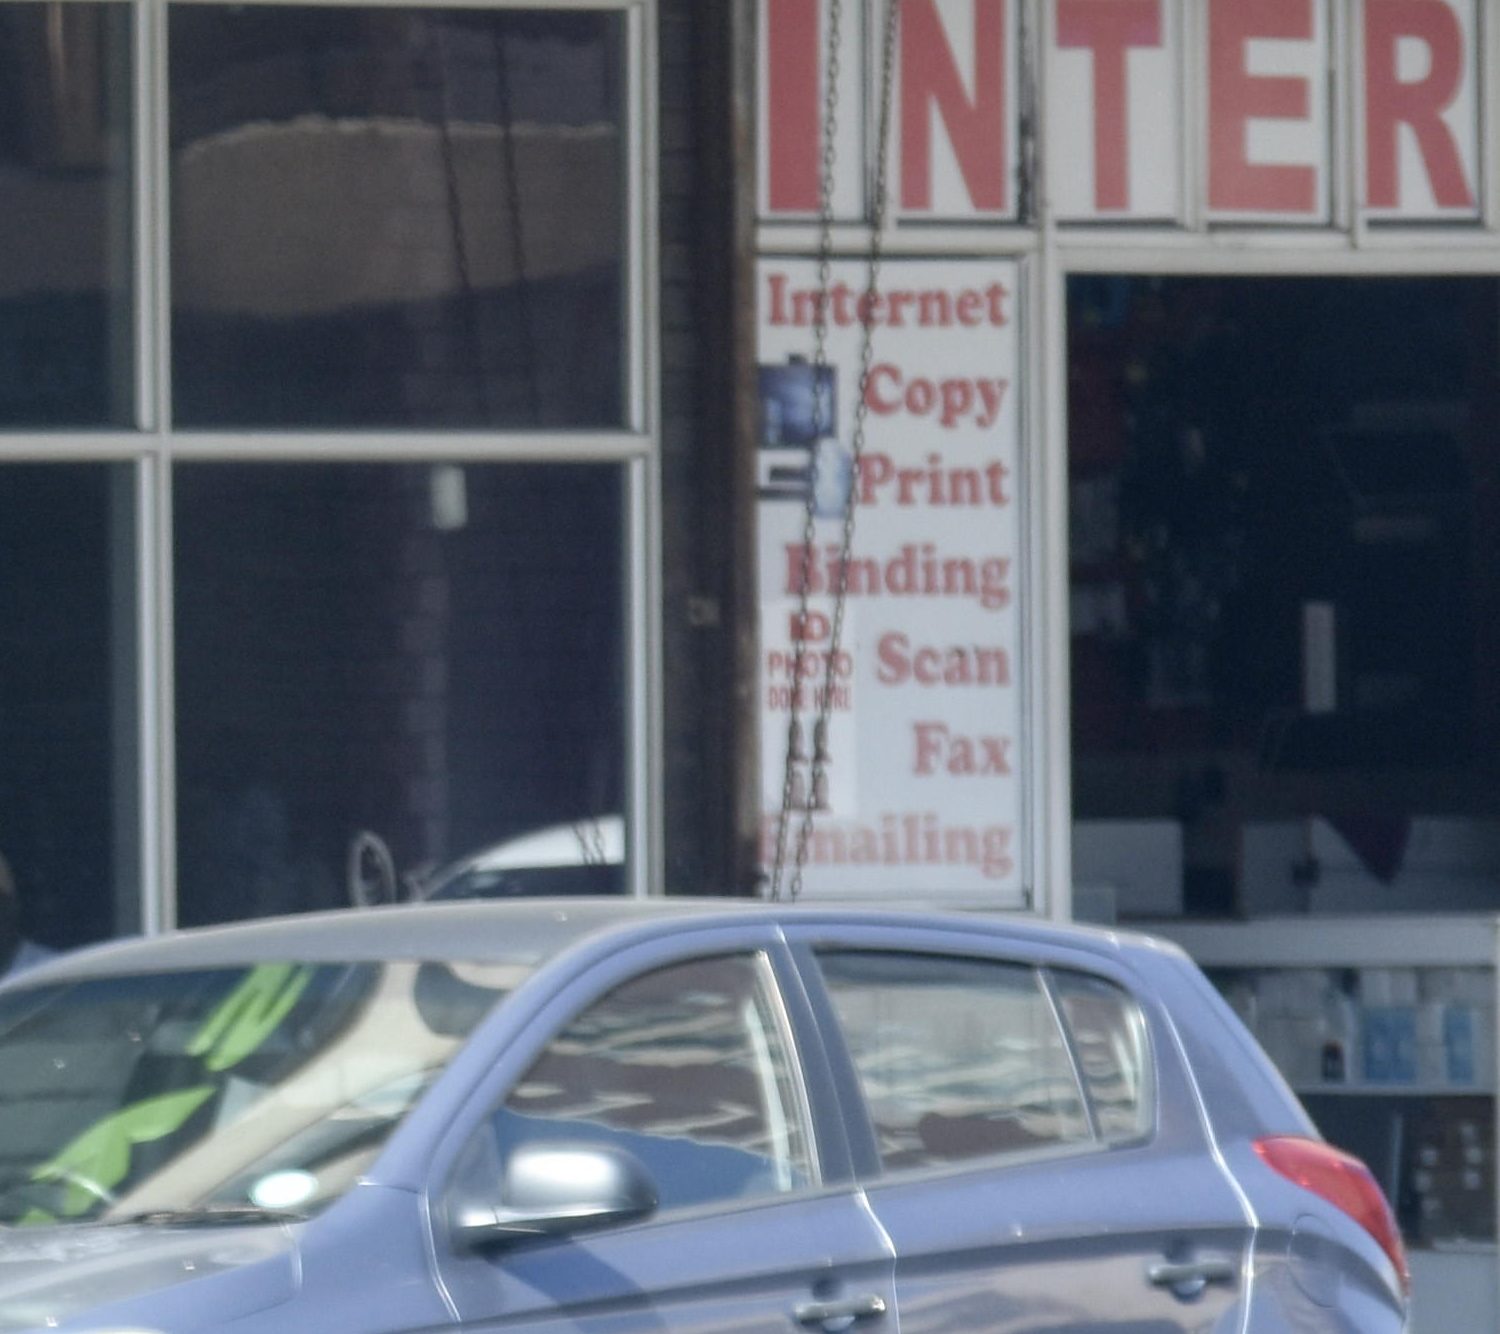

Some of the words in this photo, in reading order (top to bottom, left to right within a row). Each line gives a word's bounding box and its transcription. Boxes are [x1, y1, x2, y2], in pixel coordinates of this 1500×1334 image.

[767, 273, 1009, 327] Internet
[863, 362, 1009, 429] Copy
[857, 452, 1009, 506] Print
[785, 543, 1012, 611] Binding
[876, 629, 1012, 687] Scan
[912, 720, 1012, 777] Fax
